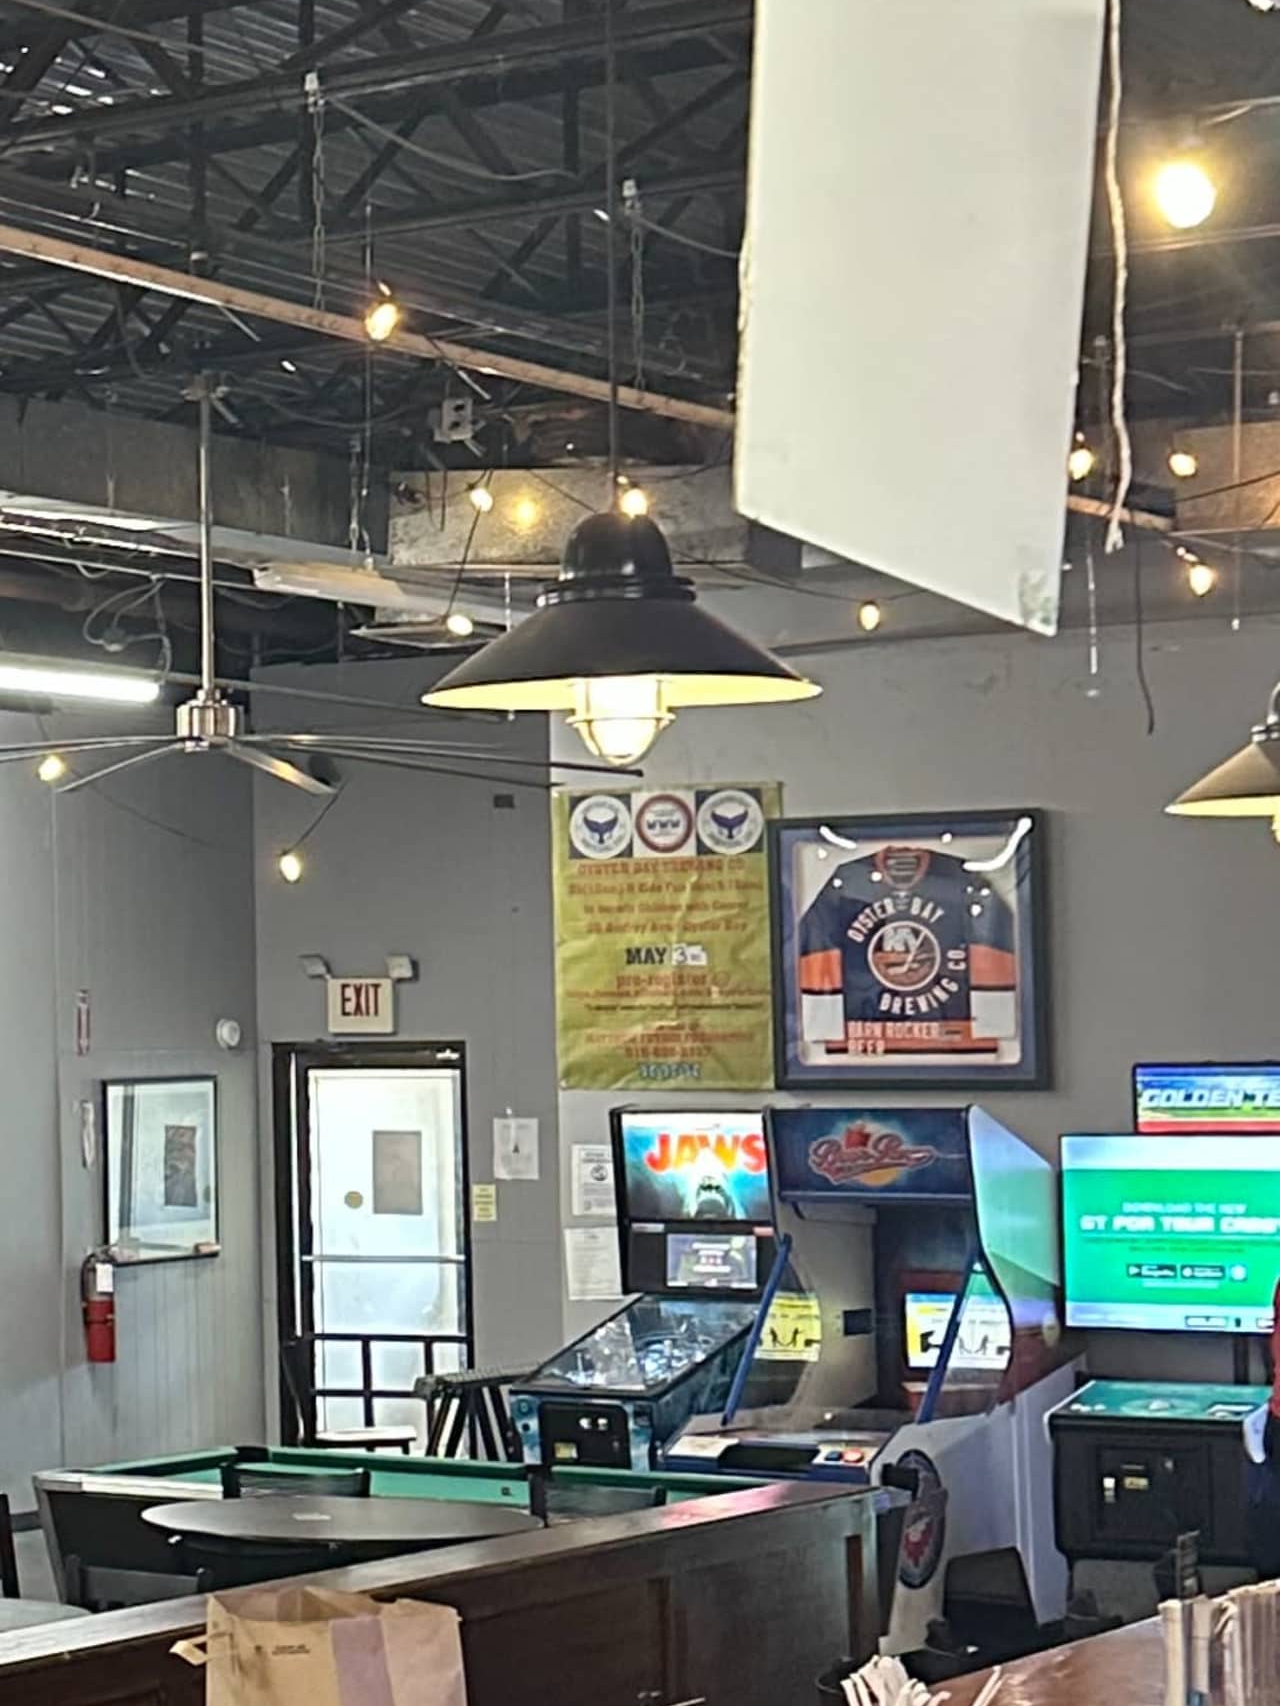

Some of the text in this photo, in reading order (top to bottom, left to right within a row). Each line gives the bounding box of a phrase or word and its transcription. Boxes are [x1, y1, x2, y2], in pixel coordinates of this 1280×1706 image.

[847, 897, 944, 943] OYSTER BAY
[625, 948, 667, 964] MAY
[340, 983, 383, 1017] EXIT
[879, 977, 959, 1015] BREWING
[887, 1021, 939, 1039] ROCKER
[1141, 1088, 1243, 1108] GOLDEN
[645, 1132, 768, 1173] JAWS
